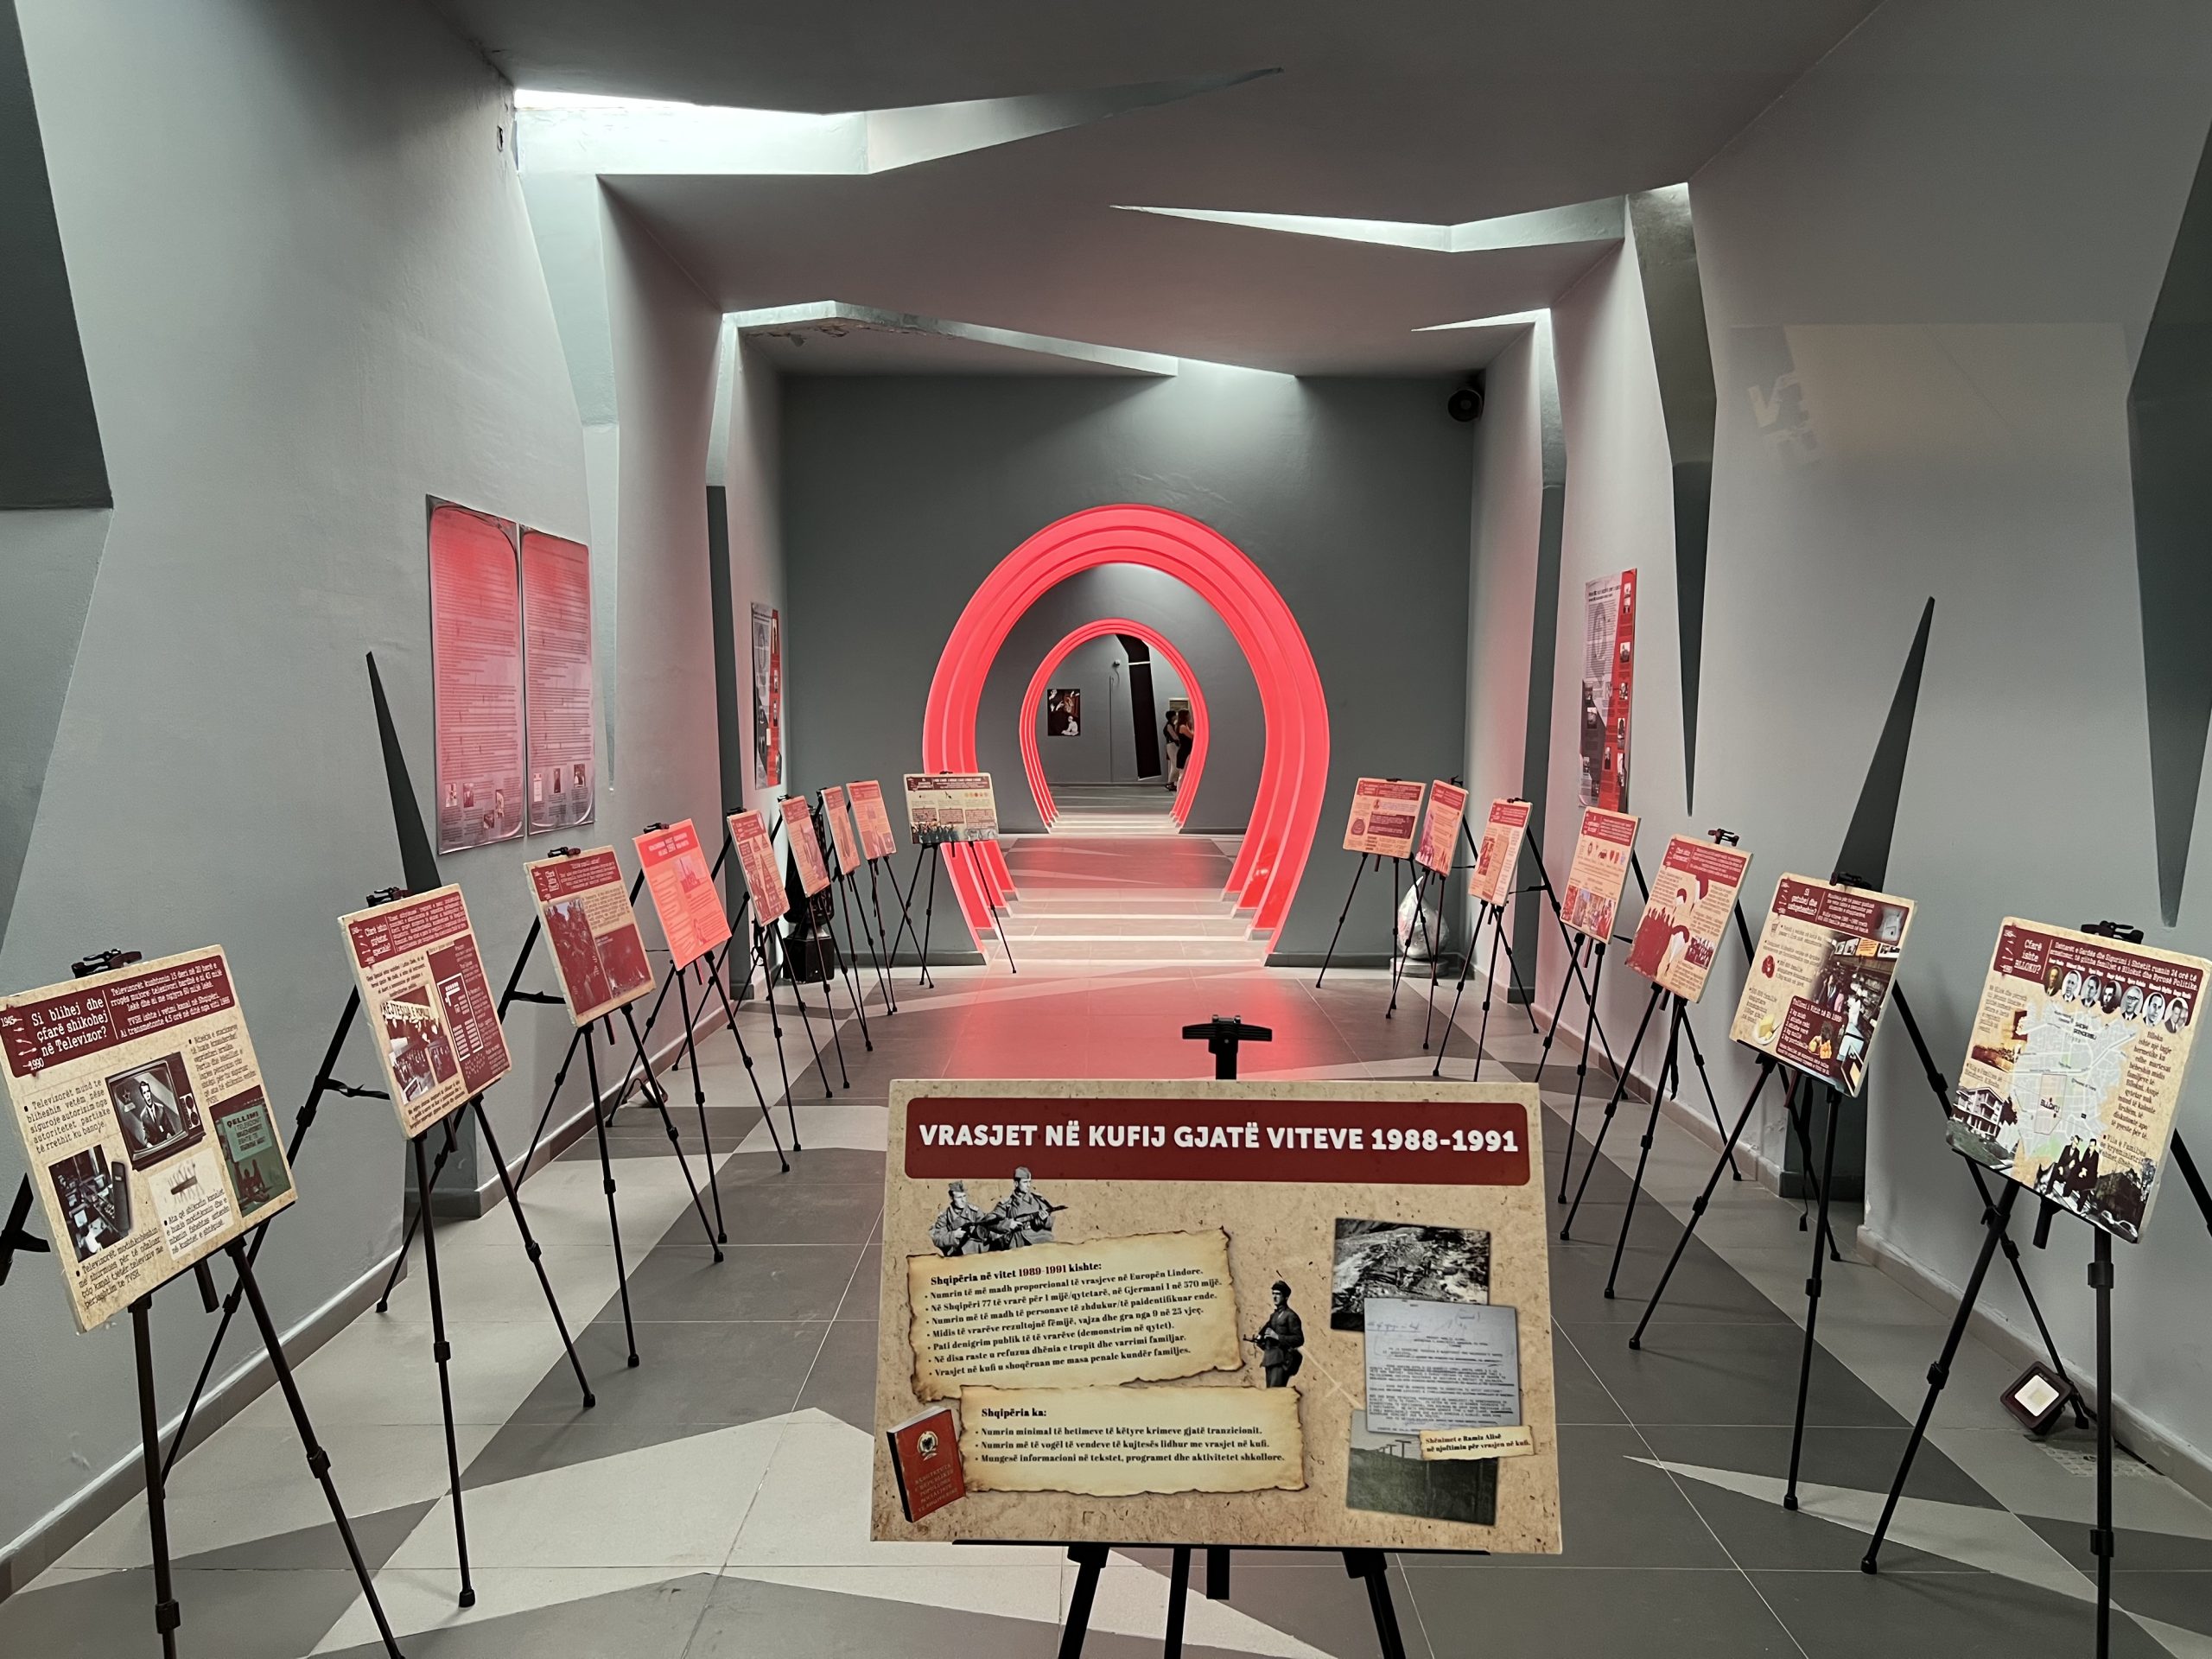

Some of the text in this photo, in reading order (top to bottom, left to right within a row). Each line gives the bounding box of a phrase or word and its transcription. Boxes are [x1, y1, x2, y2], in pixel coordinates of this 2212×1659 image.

[31, 998, 104, 1027] Si blihej dhe
[36, 1010, 108, 1041] çfarë shikohej
[41, 1026, 107, 1057] në Televizor?
[919, 1120, 1519, 1152] VRASJET NË KUFIJ GJATË VITEVE 1988-1991
[931, 1273, 977, 1286] Shqipëria
[980, 1271, 991, 1280] në
[994, 1270, 1015, 1279] vitet
[1068, 1262, 1101, 1272] kishte:
[931, 1289, 962, 1298] Numrin
[988, 1284, 1012, 1293] madh
[1014, 1279, 1068, 1293] proporcional
[1081, 1275, 1116, 1285] vrasjeve
[1129, 1270, 1165, 1280] Europën
[1166, 1268, 1203, 1276] Lindore.
[931, 1315, 963, 1324] Numrin
[990, 1310, 1014, 1319] madh
[1026, 1306, 1068, 1318] personave
[1081, 1299, 1128, 1310] zhdukur/të
[1130, 1294, 1192, 1307] paidentifikuar
[1193, 1291, 1217, 1300] ende.
[944, 1300, 980, 1311] Shqipëri
[1028, 1294, 1043, 1305] për
[1051, 1288, 1109, 1301] mijë/qytetarë,
[1124, 1283, 1163, 1295] Gjermani
[1201, 1278, 1221, 1287] mijë.
[932, 1328, 955, 1337] Midis
[967, 1325, 999, 1333] vrarëve
[1001, 1319, 1045, 1331] rezultojnë
[1047, 1317, 1076, 1326] fëmijë,
[1078, 1315, 1100, 1325] vajza
[1119, 1313, 1134, 1322] gra
[1184, 1306, 1203, 1316] vjeç.
[933, 1341, 950, 1350] Pati
[951, 1338, 990, 1348] denigrim
[992, 1335, 1020, 1346] publik
[1043, 1331, 1075, 1339] vrarëve
[1077, 1325, 1131, 1337] (demonstrim
[1146, 1321, 1173, 1332] qytet).
[935, 1367, 964, 1376] Vrasjet
[979, 1363, 995, 1372] kufi
[1005, 1360, 1050, 1370] shoqëruan
[1090, 1352, 1118, 1363] penale
[1120, 1349, 1152, 1358] kundër
[1154, 1346, 1190, 1356] familjes.
[982, 1408, 1046, 1419] Shqipëria ka:
[1040, 1440, 1063, 1450] vogël
[1122, 1440, 1158, 1450] kujtesës
[1205, 1440, 1234, 1449] vrasjet
[1249, 1439, 1268, 1447] kufi.
[1116, 1427, 1144, 1436] këtyre
[1183, 1427, 1205, 1436] gjatë
[981, 1454, 1017, 1463] Mungesë
[1126, 1454, 1171, 1463] programet
[1435, 1444, 1466, 1452] njoftimin
